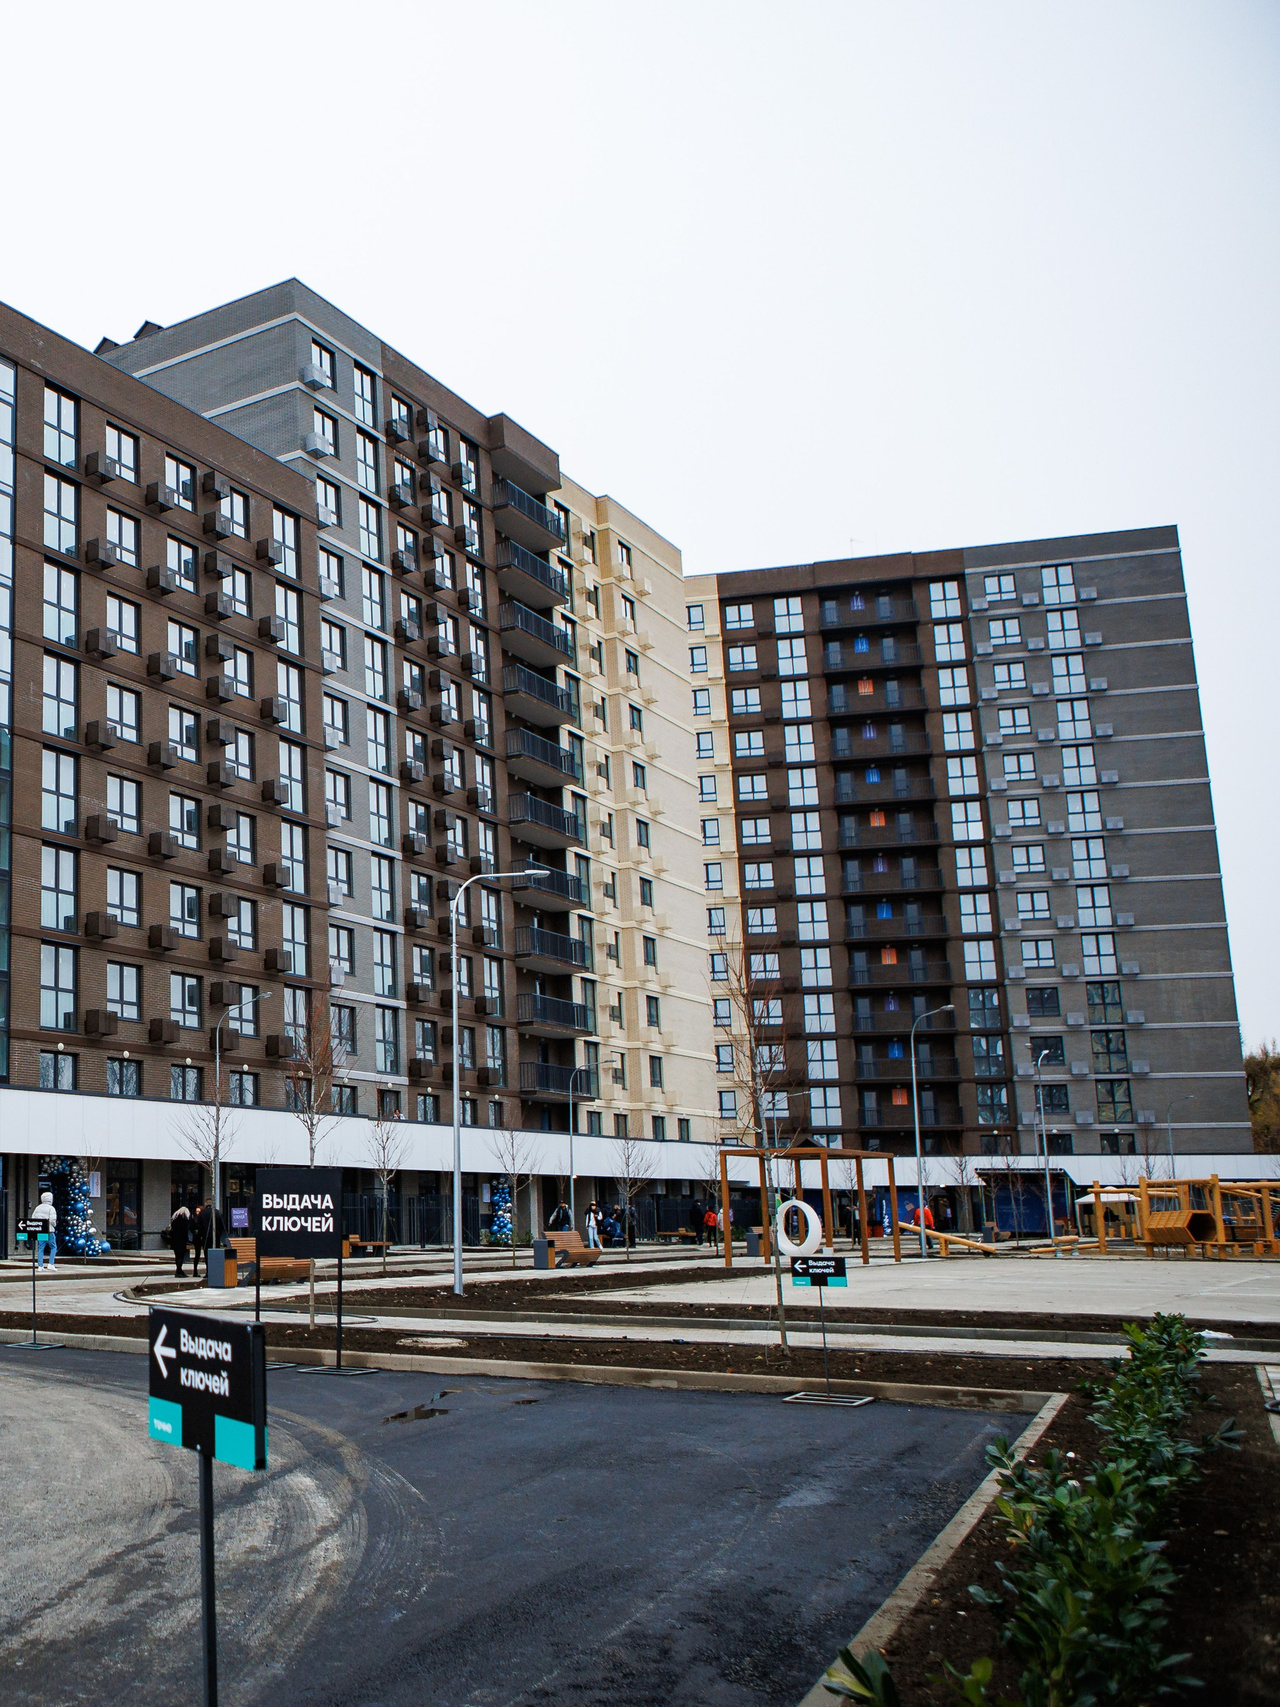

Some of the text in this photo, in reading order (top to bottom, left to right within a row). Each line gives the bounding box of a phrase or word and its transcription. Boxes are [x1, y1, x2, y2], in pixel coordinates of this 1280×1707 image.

[262, 1193, 334, 1211] ВЫДАЧА
[261, 1212, 334, 1232] КЛЮЧЕЙ
[179, 1328, 232, 1362] Выдача
[180, 1366, 230, 1397] ключей
